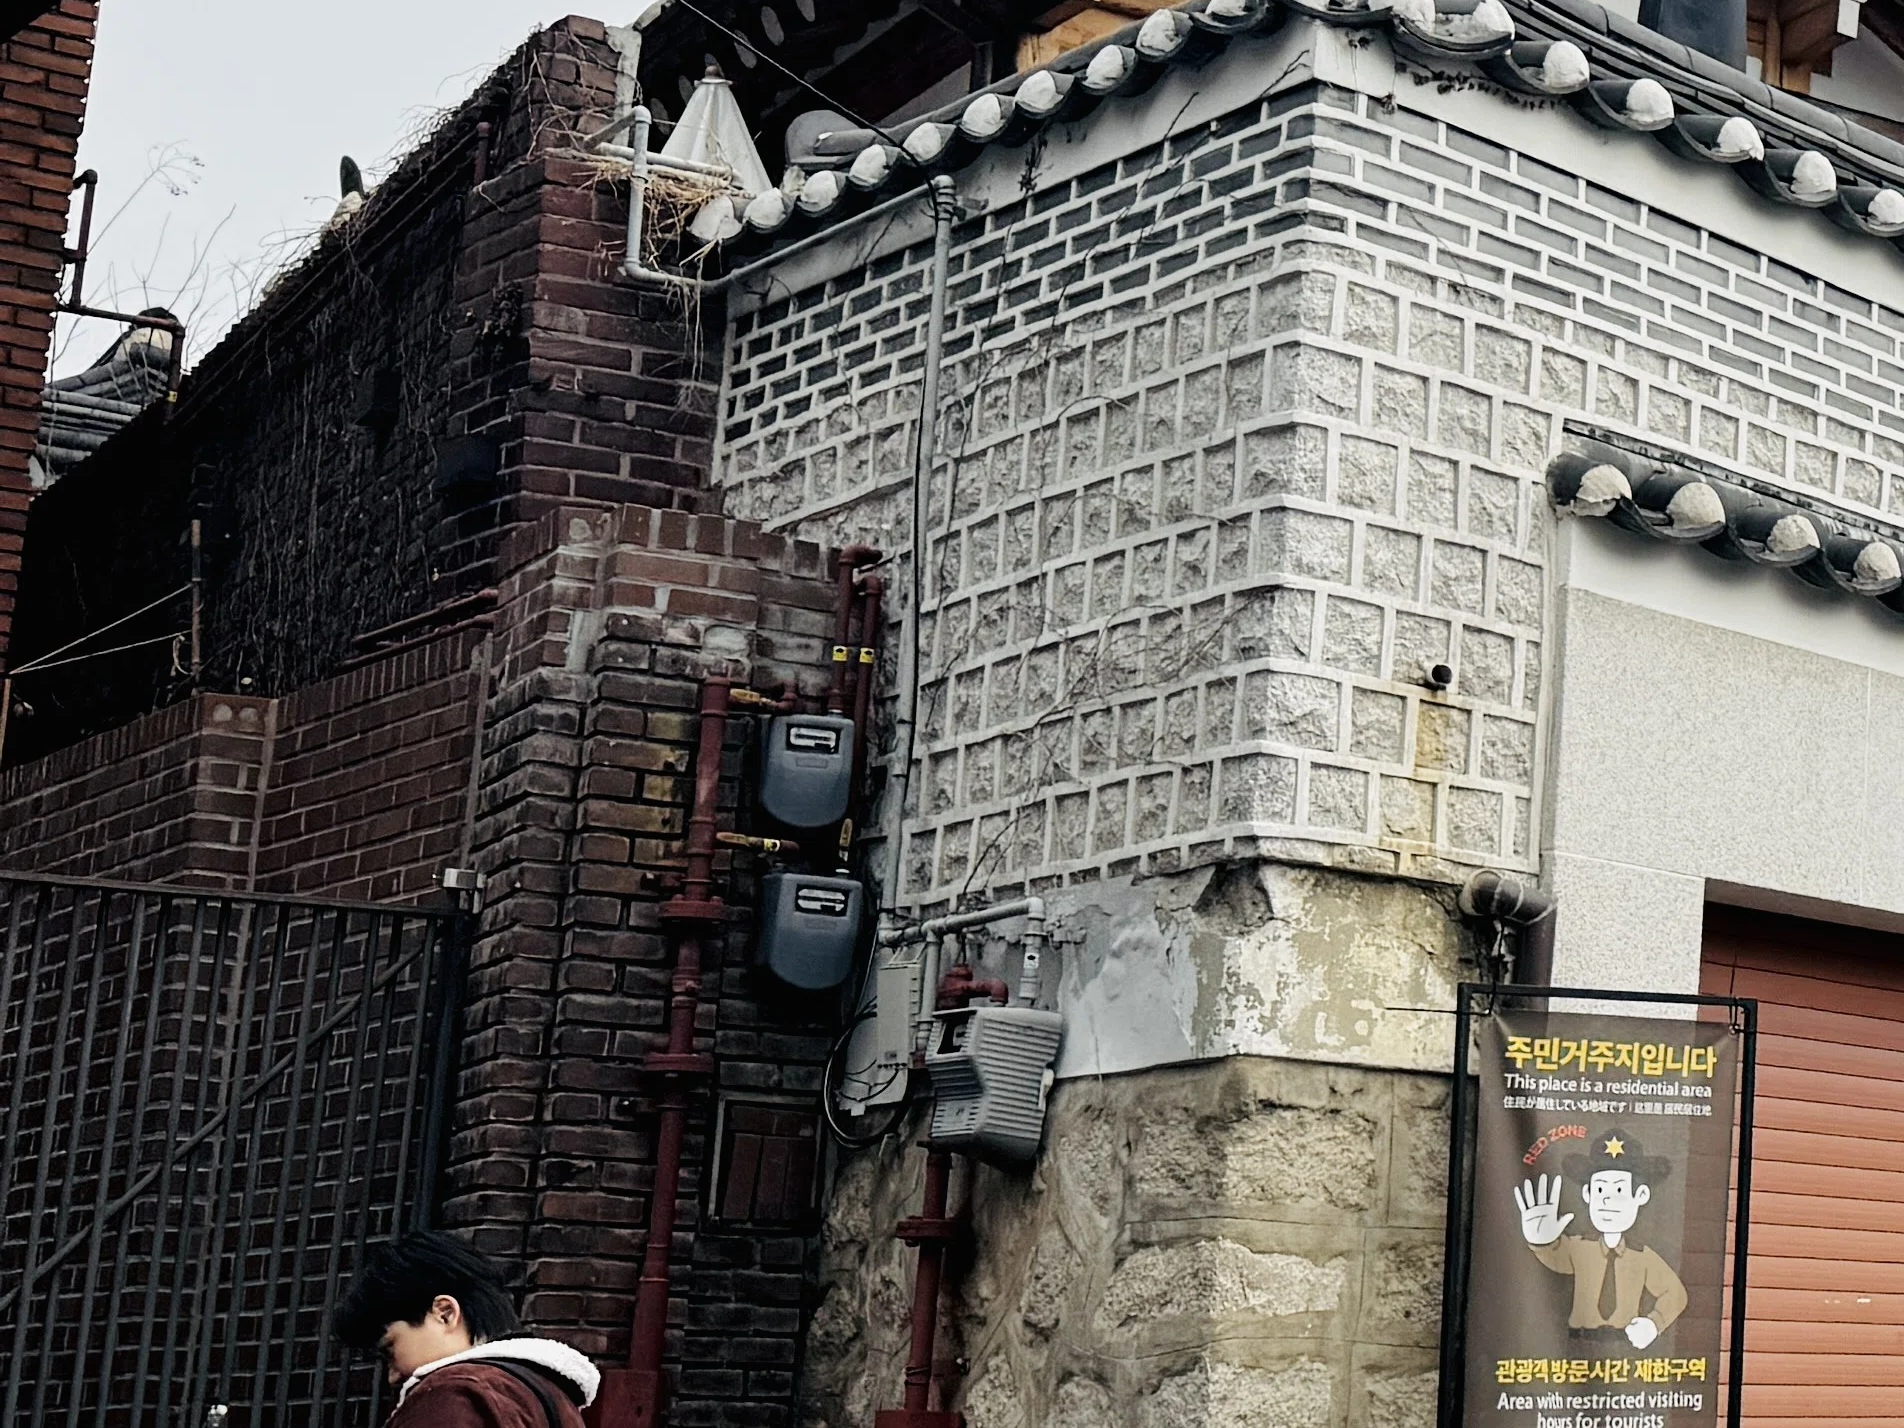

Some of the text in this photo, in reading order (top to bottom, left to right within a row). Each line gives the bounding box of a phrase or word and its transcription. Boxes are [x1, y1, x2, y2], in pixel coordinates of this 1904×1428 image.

[1505, 1036, 1717, 1078] 주민거주지입니다
[1504, 1073, 1712, 1098] This place is a residential area
[1522, 1124, 1588, 1165] RED ZONE
[1634, 1357, 1708, 1383] 제한구역
[1497, 1391, 1703, 1411] Area with restricted visiting
[1605, 1412, 1664, 1428] tourists
